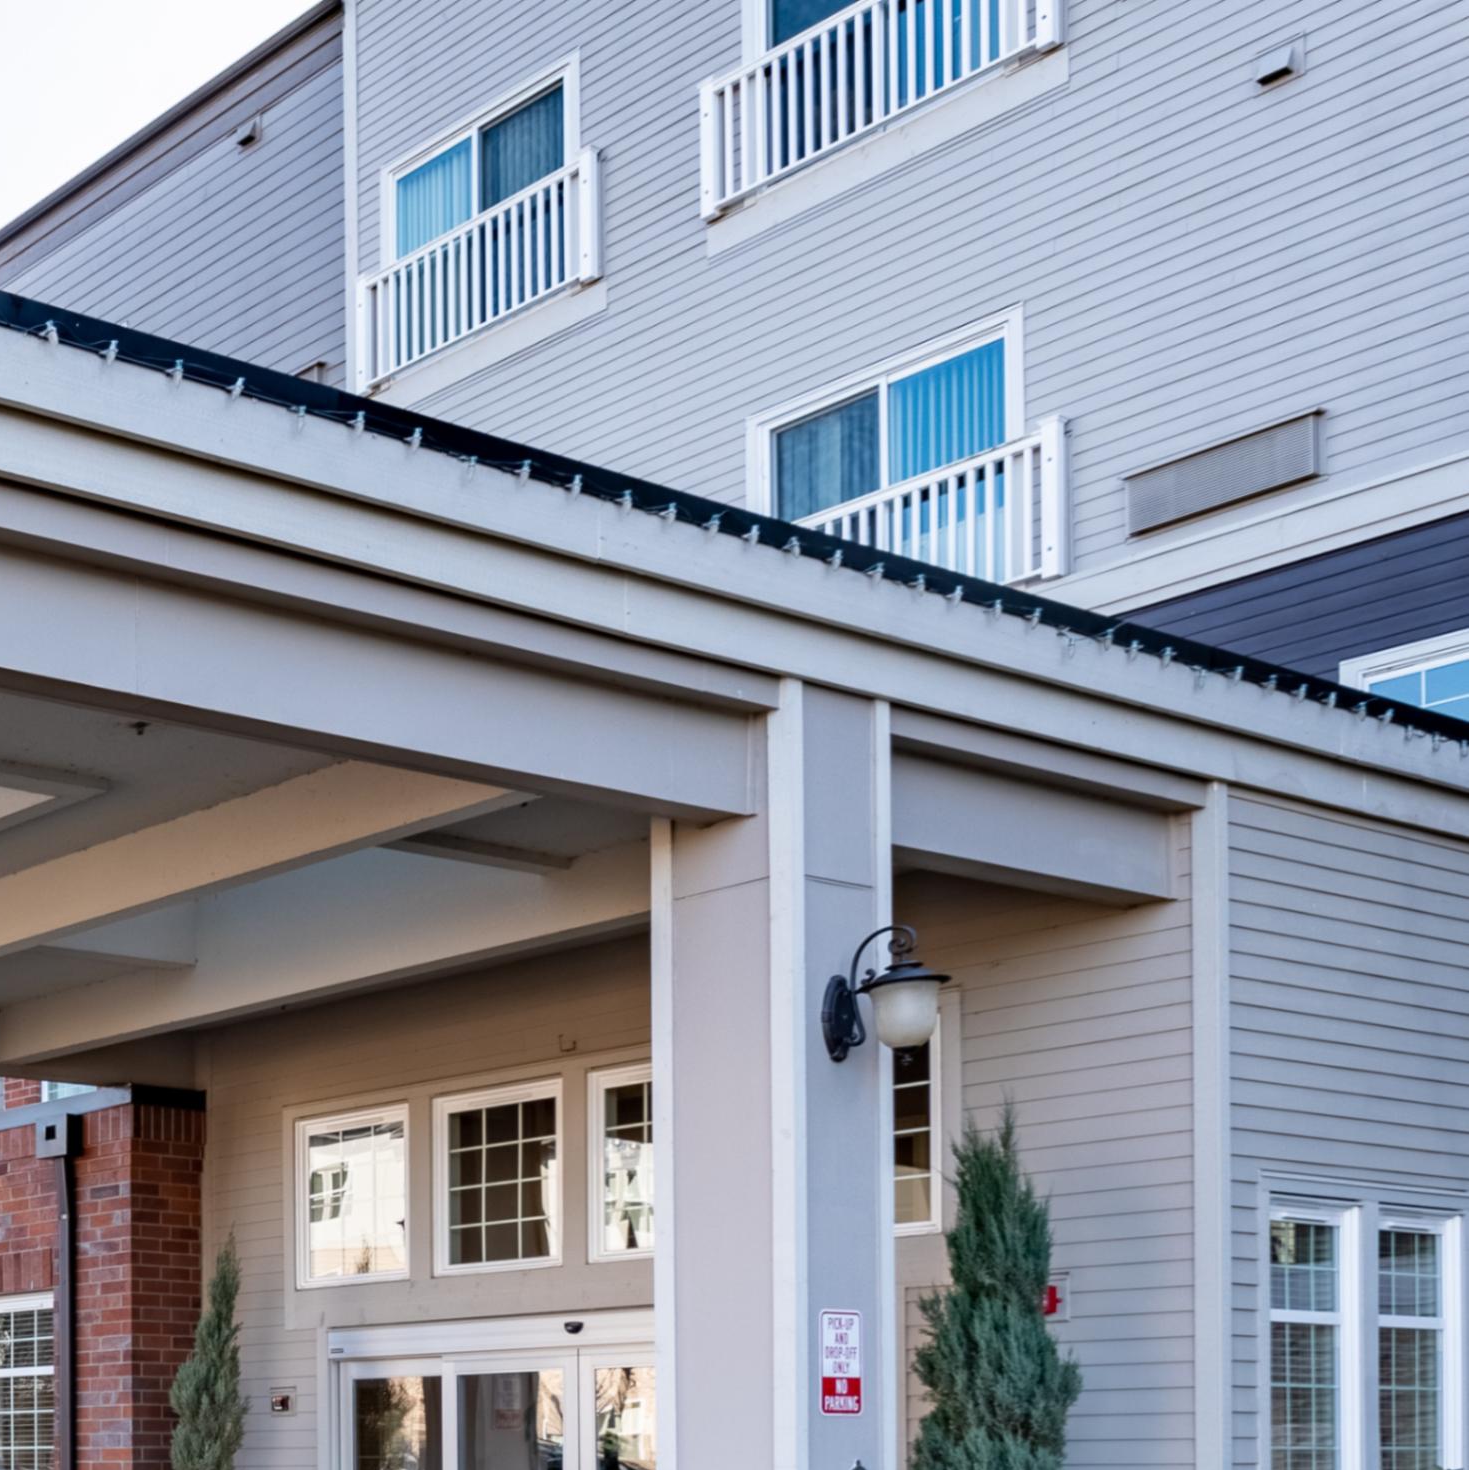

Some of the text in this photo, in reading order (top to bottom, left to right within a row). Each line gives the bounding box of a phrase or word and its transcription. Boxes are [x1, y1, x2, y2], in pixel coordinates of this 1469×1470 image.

[834, 1332, 848, 1345] AND
[833, 1361, 850, 1374] ONLY
[835, 1379, 848, 1395] NO
[824, 1395, 859, 1411] PARKING
